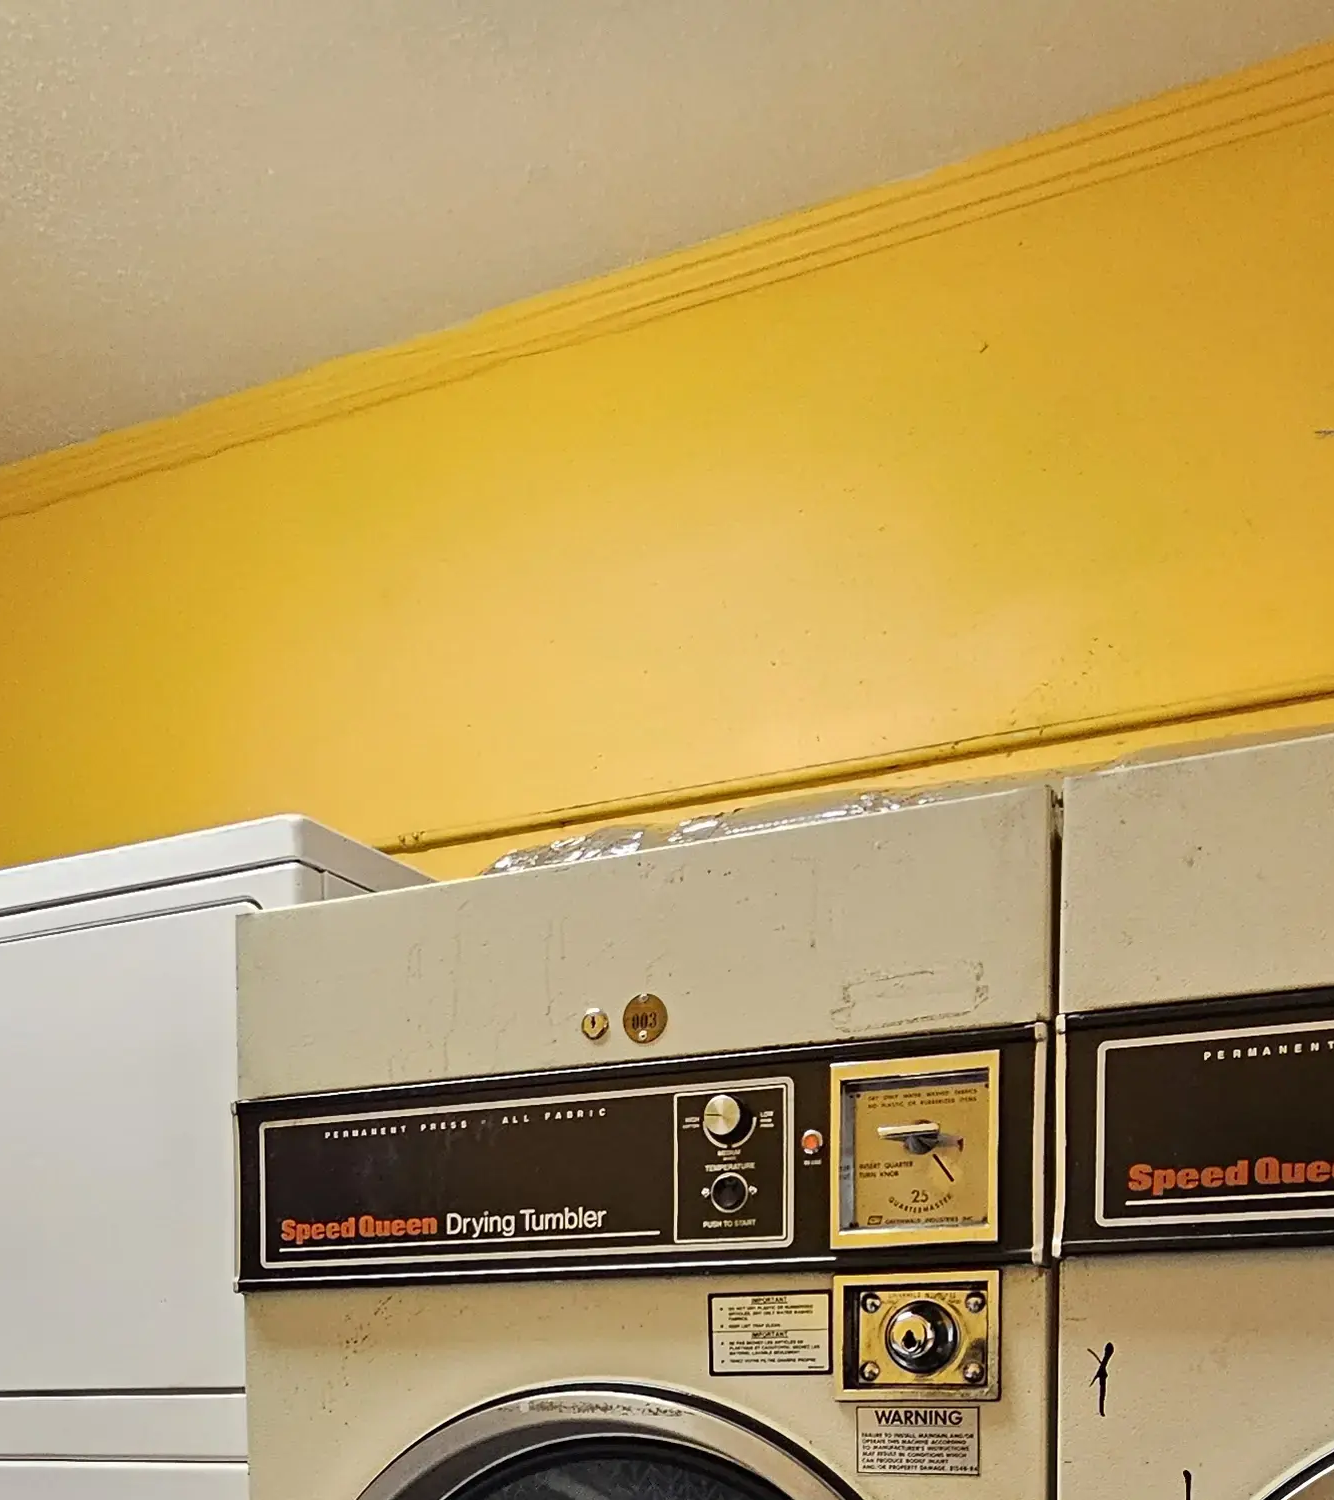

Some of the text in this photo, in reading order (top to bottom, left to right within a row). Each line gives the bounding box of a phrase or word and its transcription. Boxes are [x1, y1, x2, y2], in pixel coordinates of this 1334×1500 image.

[631, 1011, 657, 1030] 003
[324, 1107, 608, 1140] PERMANENT PRESS ALL FABRIC
[705, 1162, 755, 1172] TEMPERATURE
[1128, 1160, 1249, 1196] Speed
[911, 1189, 929, 1203] 25
[281, 1206, 607, 1245] Speed Queen Drying Tumbler
[703, 1220, 722, 1228] PUSH
[734, 1219, 756, 1227] START
[874, 1410, 963, 1425] WARNING
